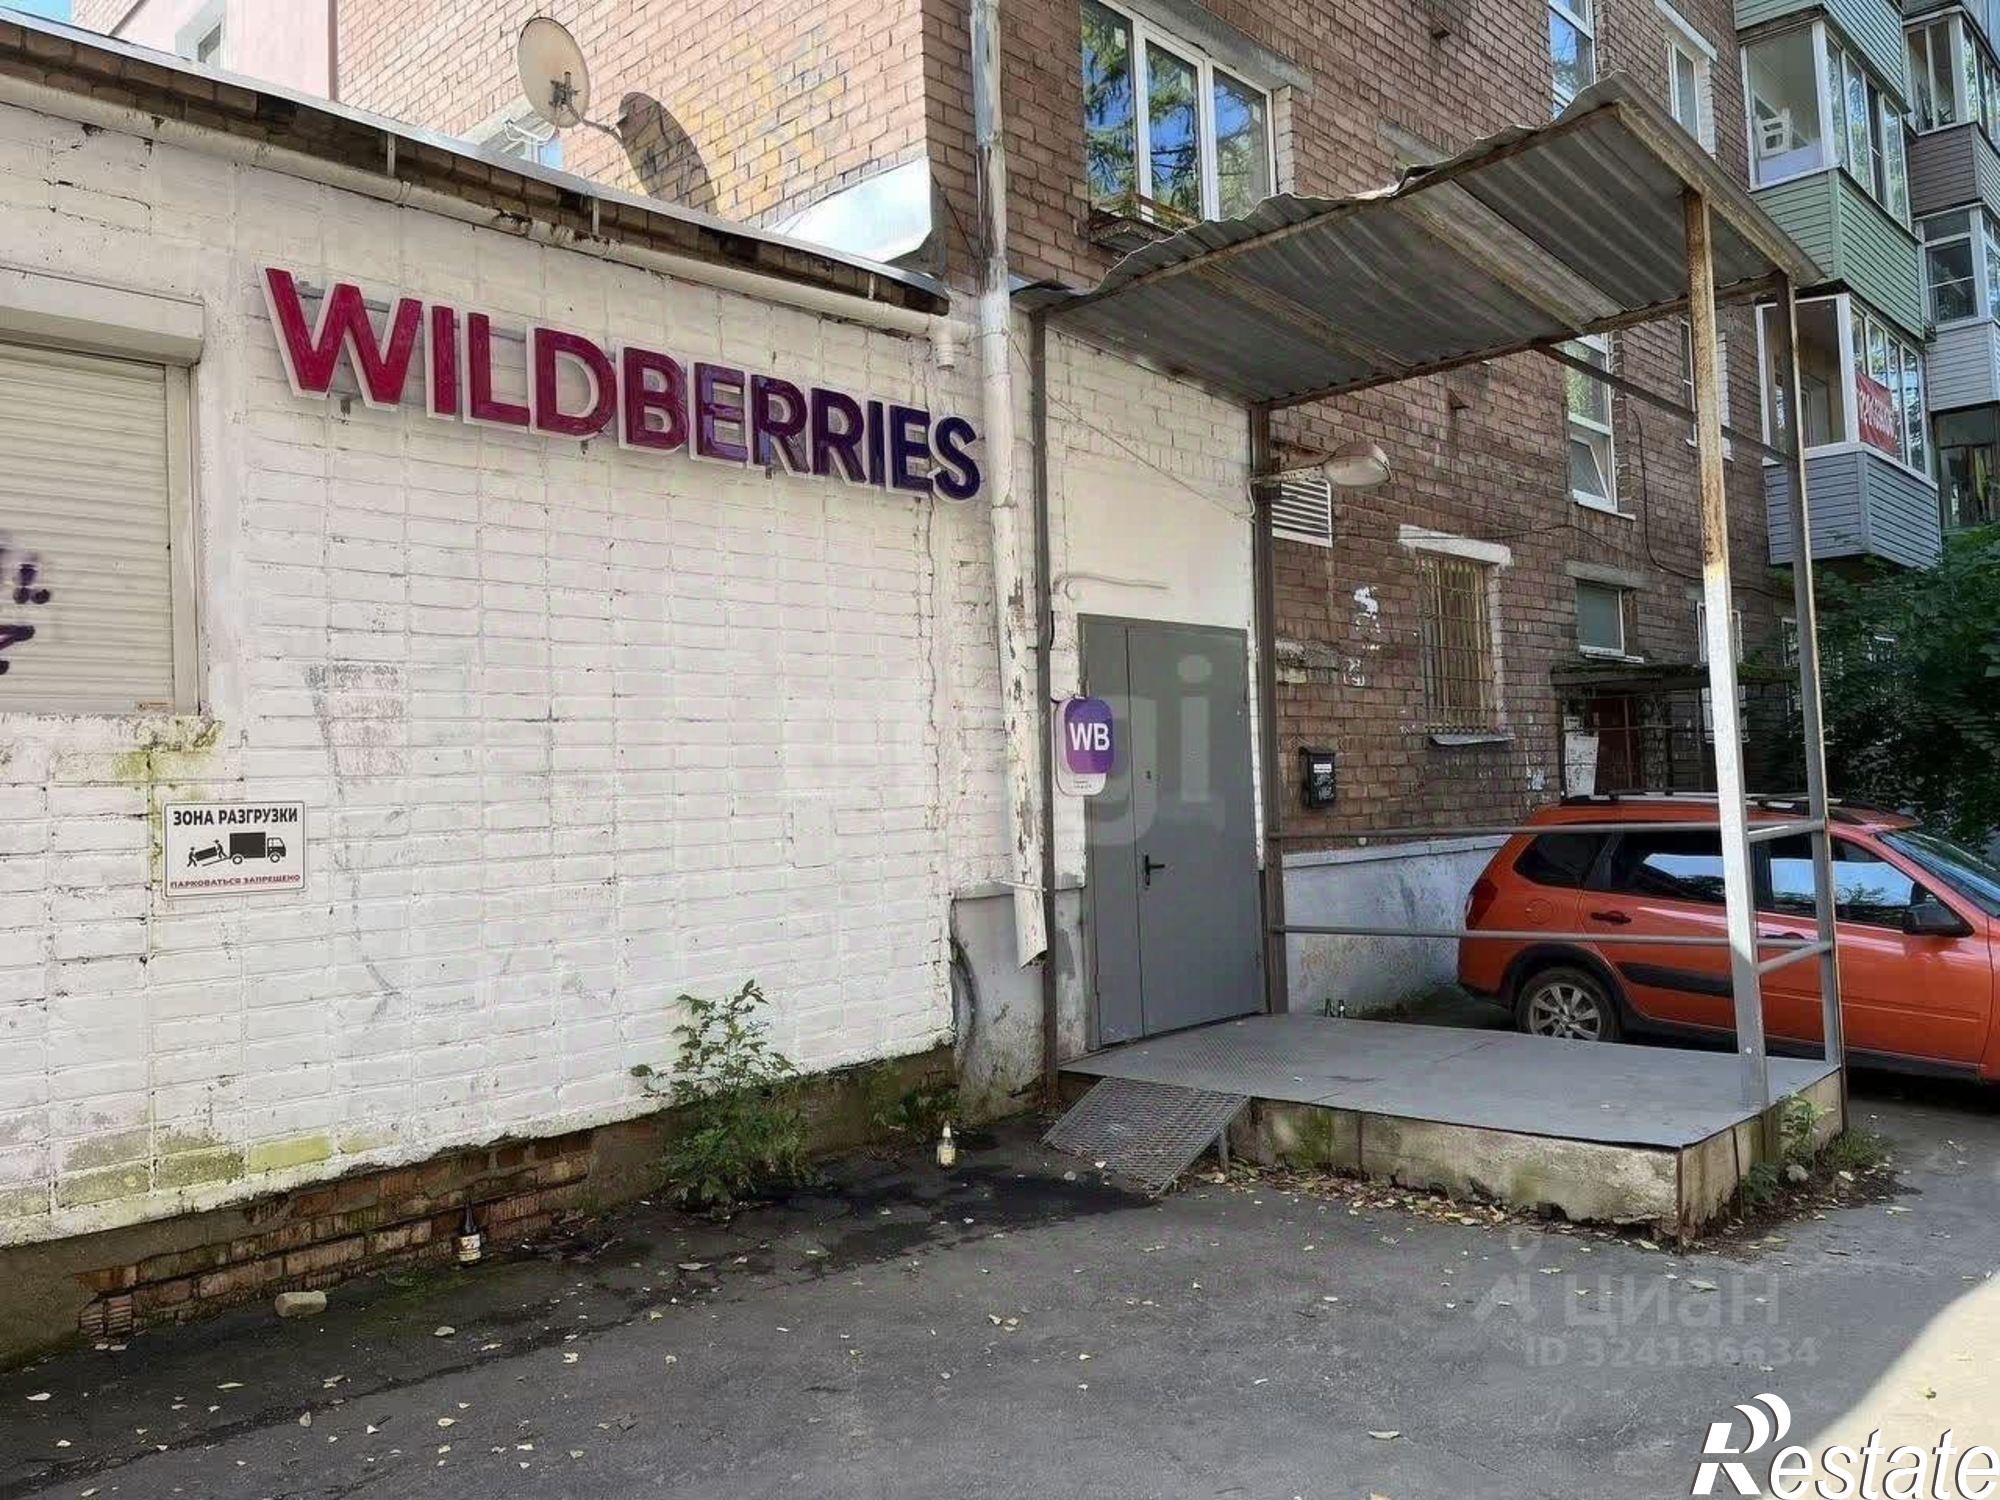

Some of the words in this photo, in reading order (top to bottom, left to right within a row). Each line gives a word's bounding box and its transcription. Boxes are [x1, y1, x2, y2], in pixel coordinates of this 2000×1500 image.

[262, 265, 985, 502] WILDBERRIES
[1068, 722, 1111, 751] WB
[173, 810, 214, 826] ЗОНА
[218, 808, 298, 824] РАЗГРУЗКИ
[170, 877, 241, 889] ПАРКОВАТЬСЯ
[243, 874, 301, 886] ЗАПРЕЩЕНО
